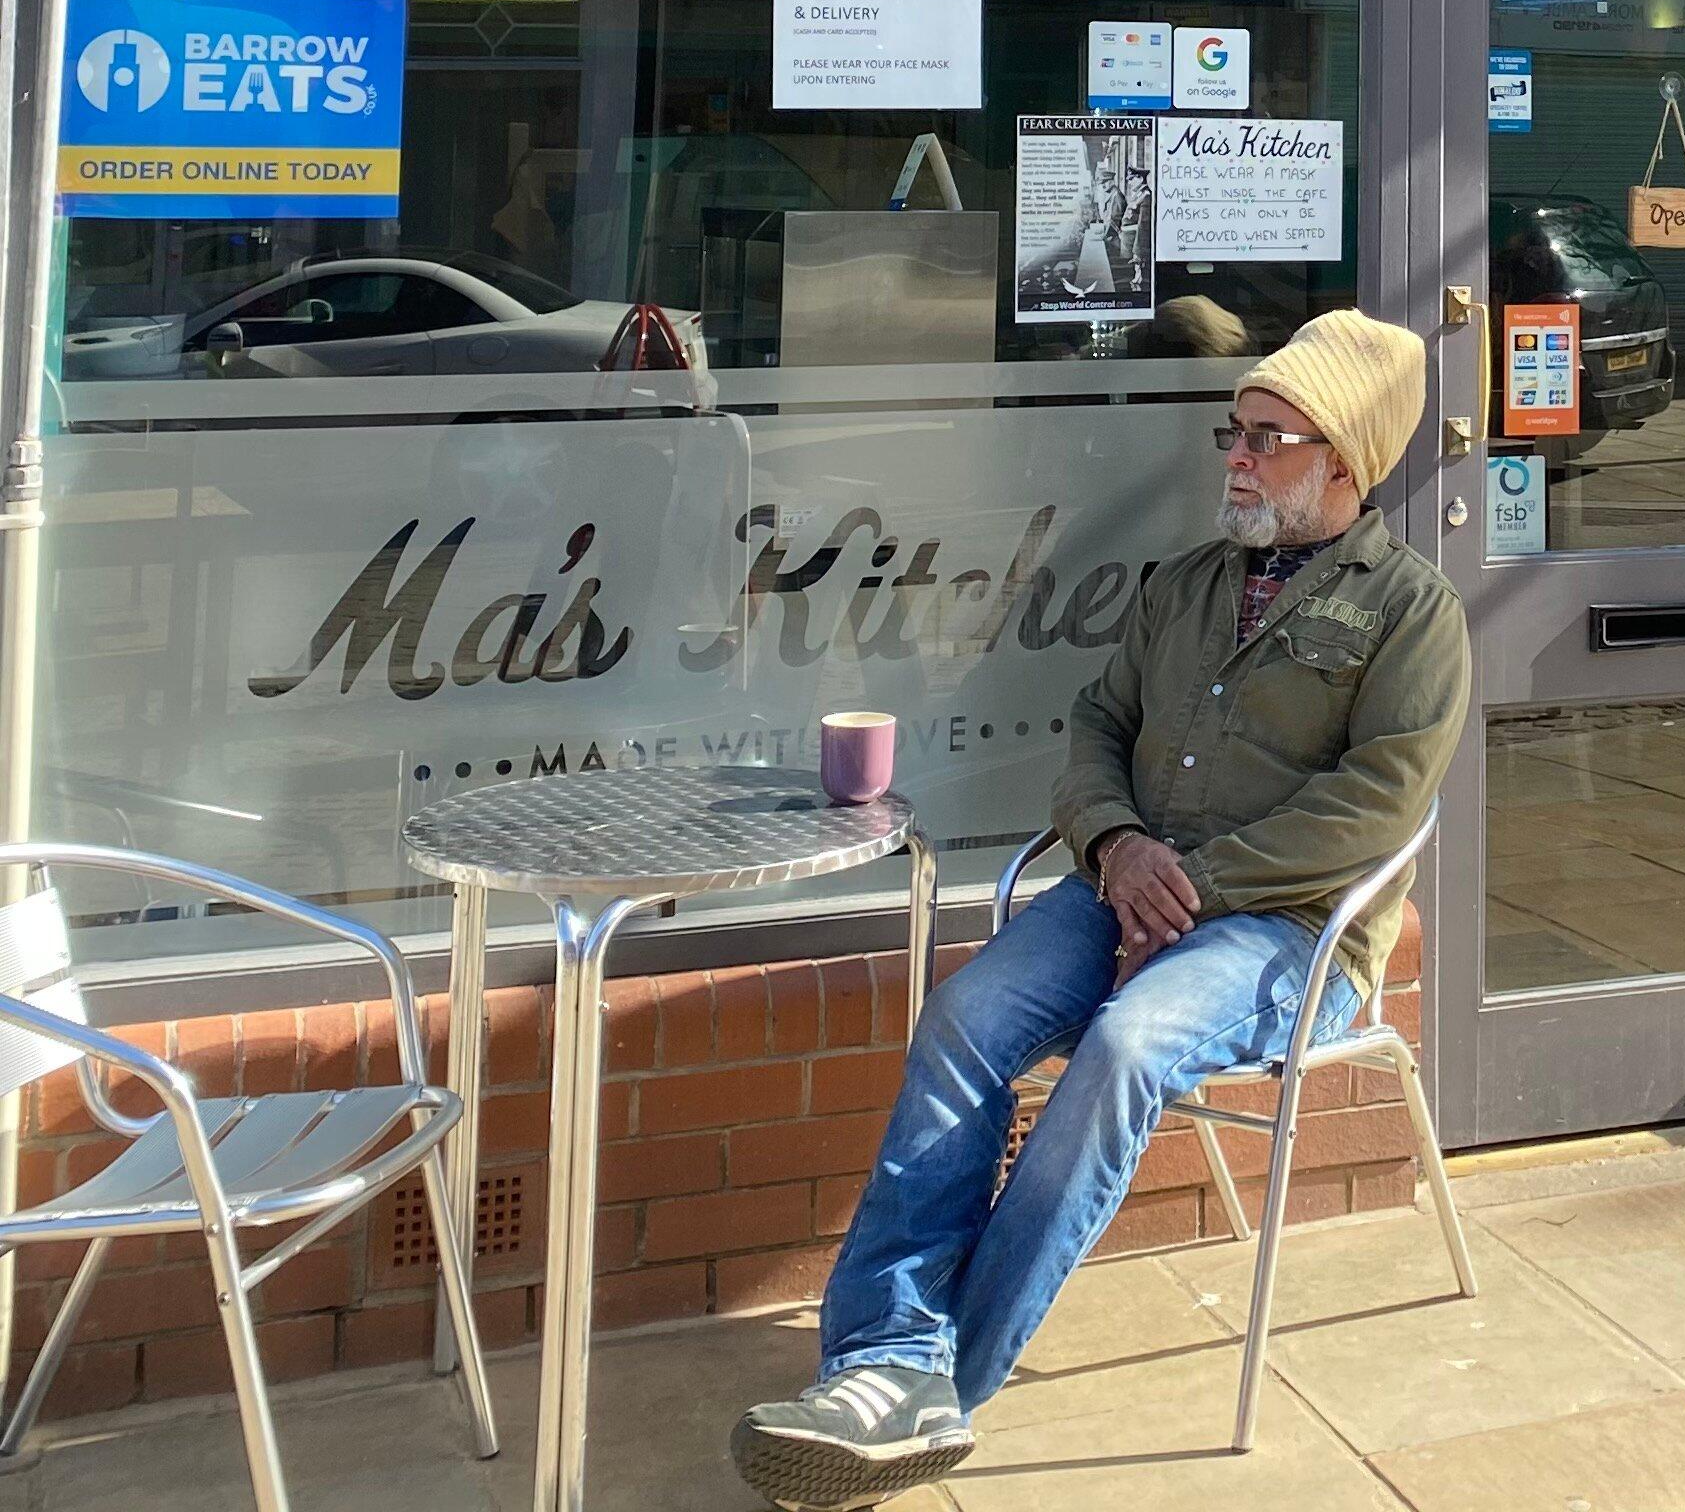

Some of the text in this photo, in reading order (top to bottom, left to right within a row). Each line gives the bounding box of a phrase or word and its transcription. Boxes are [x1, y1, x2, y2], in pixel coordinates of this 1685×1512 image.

[794, 6, 880, 21] & DELIVERY
[184, 33, 369, 64] BARROW
[793, 59, 950, 69] PLEASE WEAR YOUR FACE MASK
[793, 75, 876, 85] UPON ENTERING
[183, 63, 369, 115] EATS
[1202, 88, 1237, 98] Google
[1023, 119, 1150, 129] FEAR CREATES SLAVES
[1167, 124, 1331, 159] Ma's Kitchen
[79, 160, 373, 181] ORDER ONLINE TODAY
[1162, 164, 1316, 180] PLEASE WEAR A MASK
[1162, 187, 1327, 199] WHILST INSIDE THE CAFE
[1162, 208, 1316, 221] MASKS CAN ONLY BE
[1177, 228, 1325, 243] REMOVED WHEN SEATED
[1549, 354, 1568, 362] VISA
[1495, 502, 1527, 521] fsb
[1497, 523, 1527, 531] MEMBER
[247, 503, 1159, 701] Ma's Kitche
